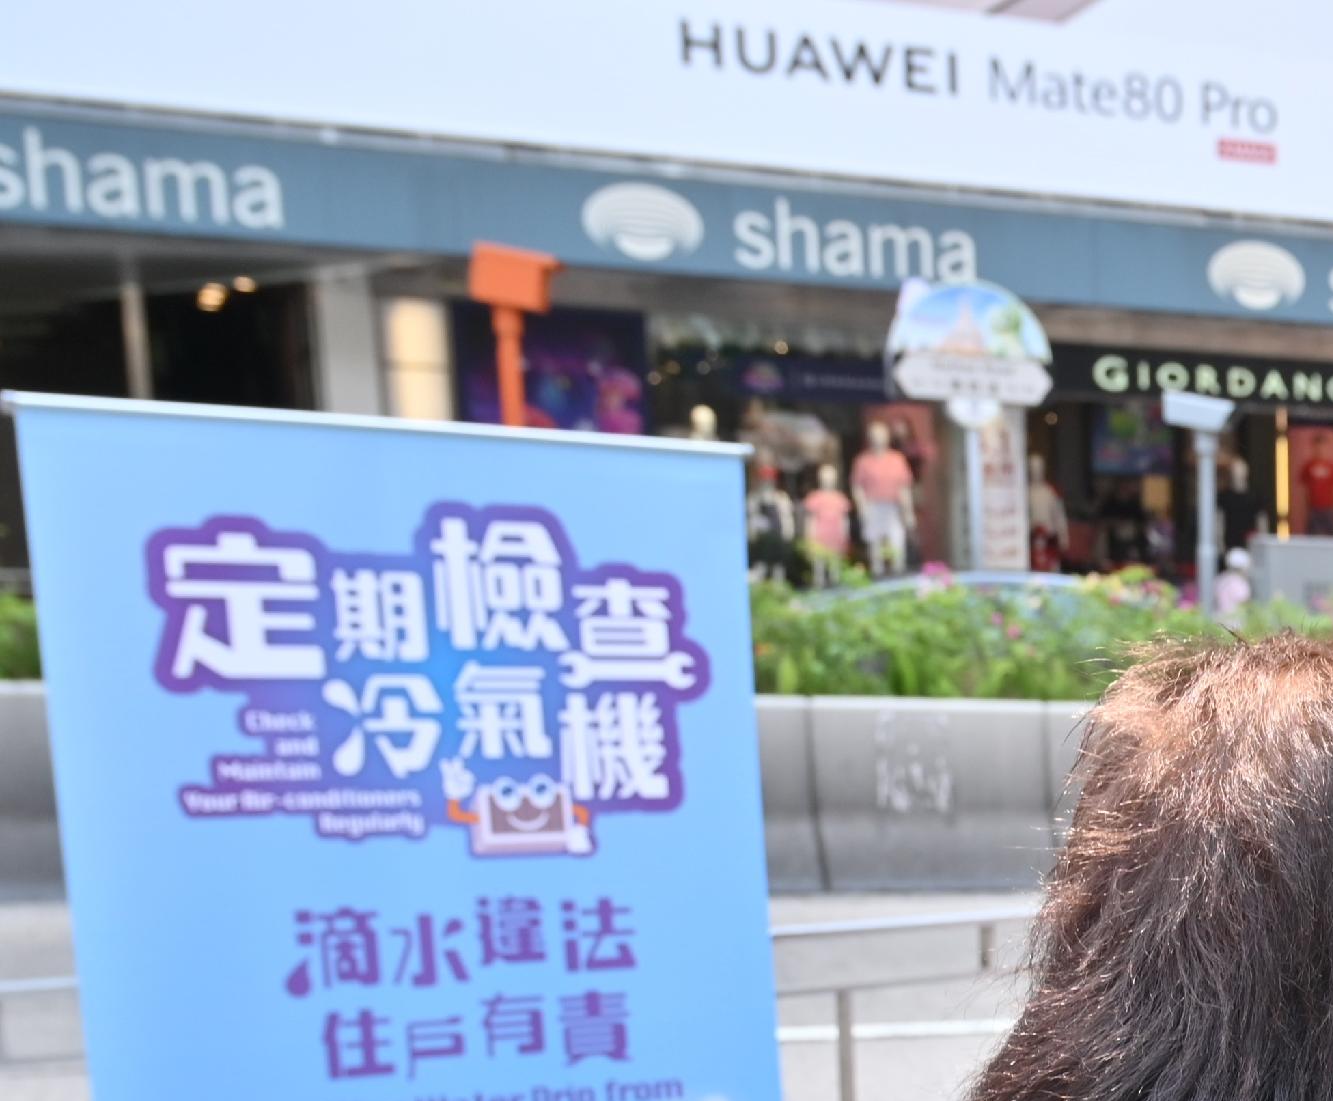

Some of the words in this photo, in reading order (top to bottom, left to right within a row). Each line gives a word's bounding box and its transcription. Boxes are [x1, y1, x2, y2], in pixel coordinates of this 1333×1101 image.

[679, 19, 961, 98] HUAWEI
[986, 56, 1184, 125] Mate80
[1200, 80, 1279, 135] Pro
[0, 127, 284, 231] shama
[733, 197, 976, 283] shama
[163, 516, 696, 690] 定期檢查
[244, 708, 316, 733] Check
[274, 735, 321, 757] and
[322, 661, 669, 800] 冷氣機
[182, 789, 238, 814] Your
[217, 760, 322, 782] Maintain
[317, 811, 426, 840] Regularly
[283, 896, 637, 999] 滴水違法
